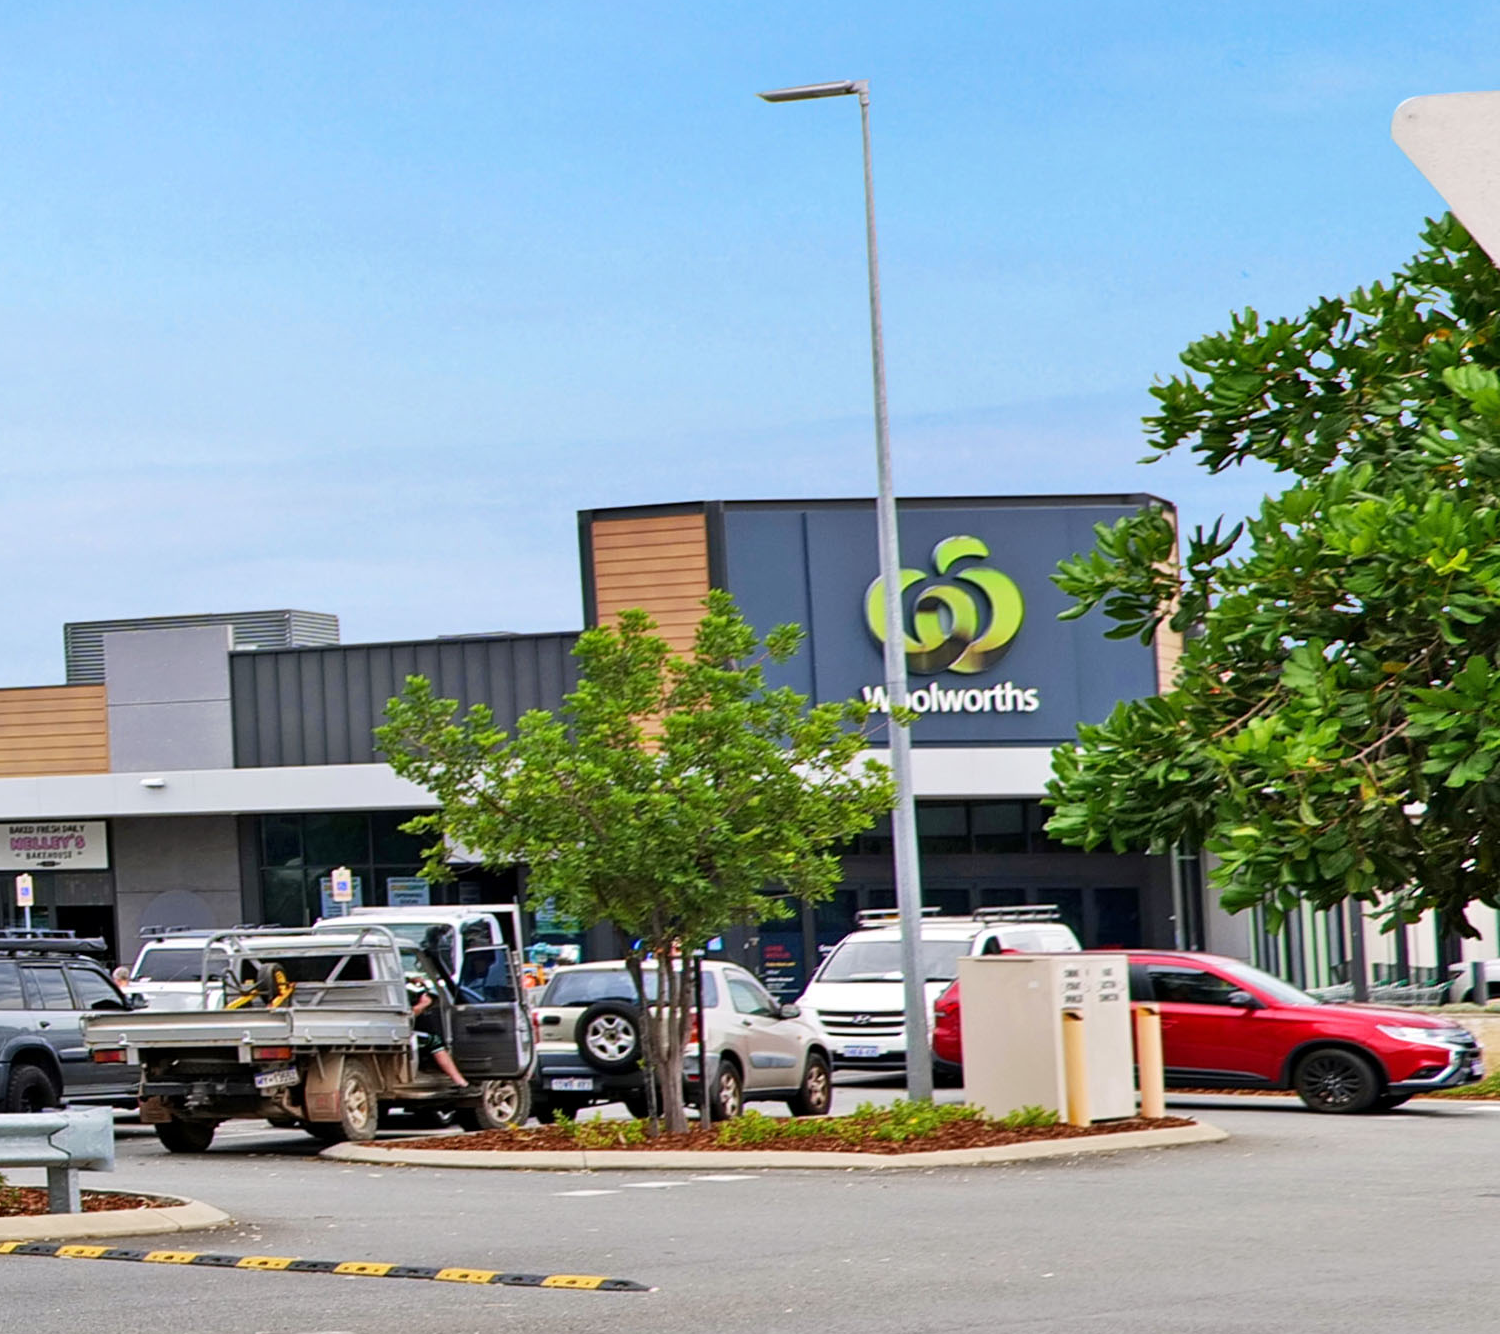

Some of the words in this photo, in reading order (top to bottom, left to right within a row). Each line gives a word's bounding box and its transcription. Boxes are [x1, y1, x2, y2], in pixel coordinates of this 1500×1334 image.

[862, 681, 1040, 713] Wolworths
[9, 826, 35, 834] BAKED
[36, 825, 61, 833] FRESH
[62, 824, 86, 833] DAILY
[26, 851, 73, 860] BAKEHOUSE
